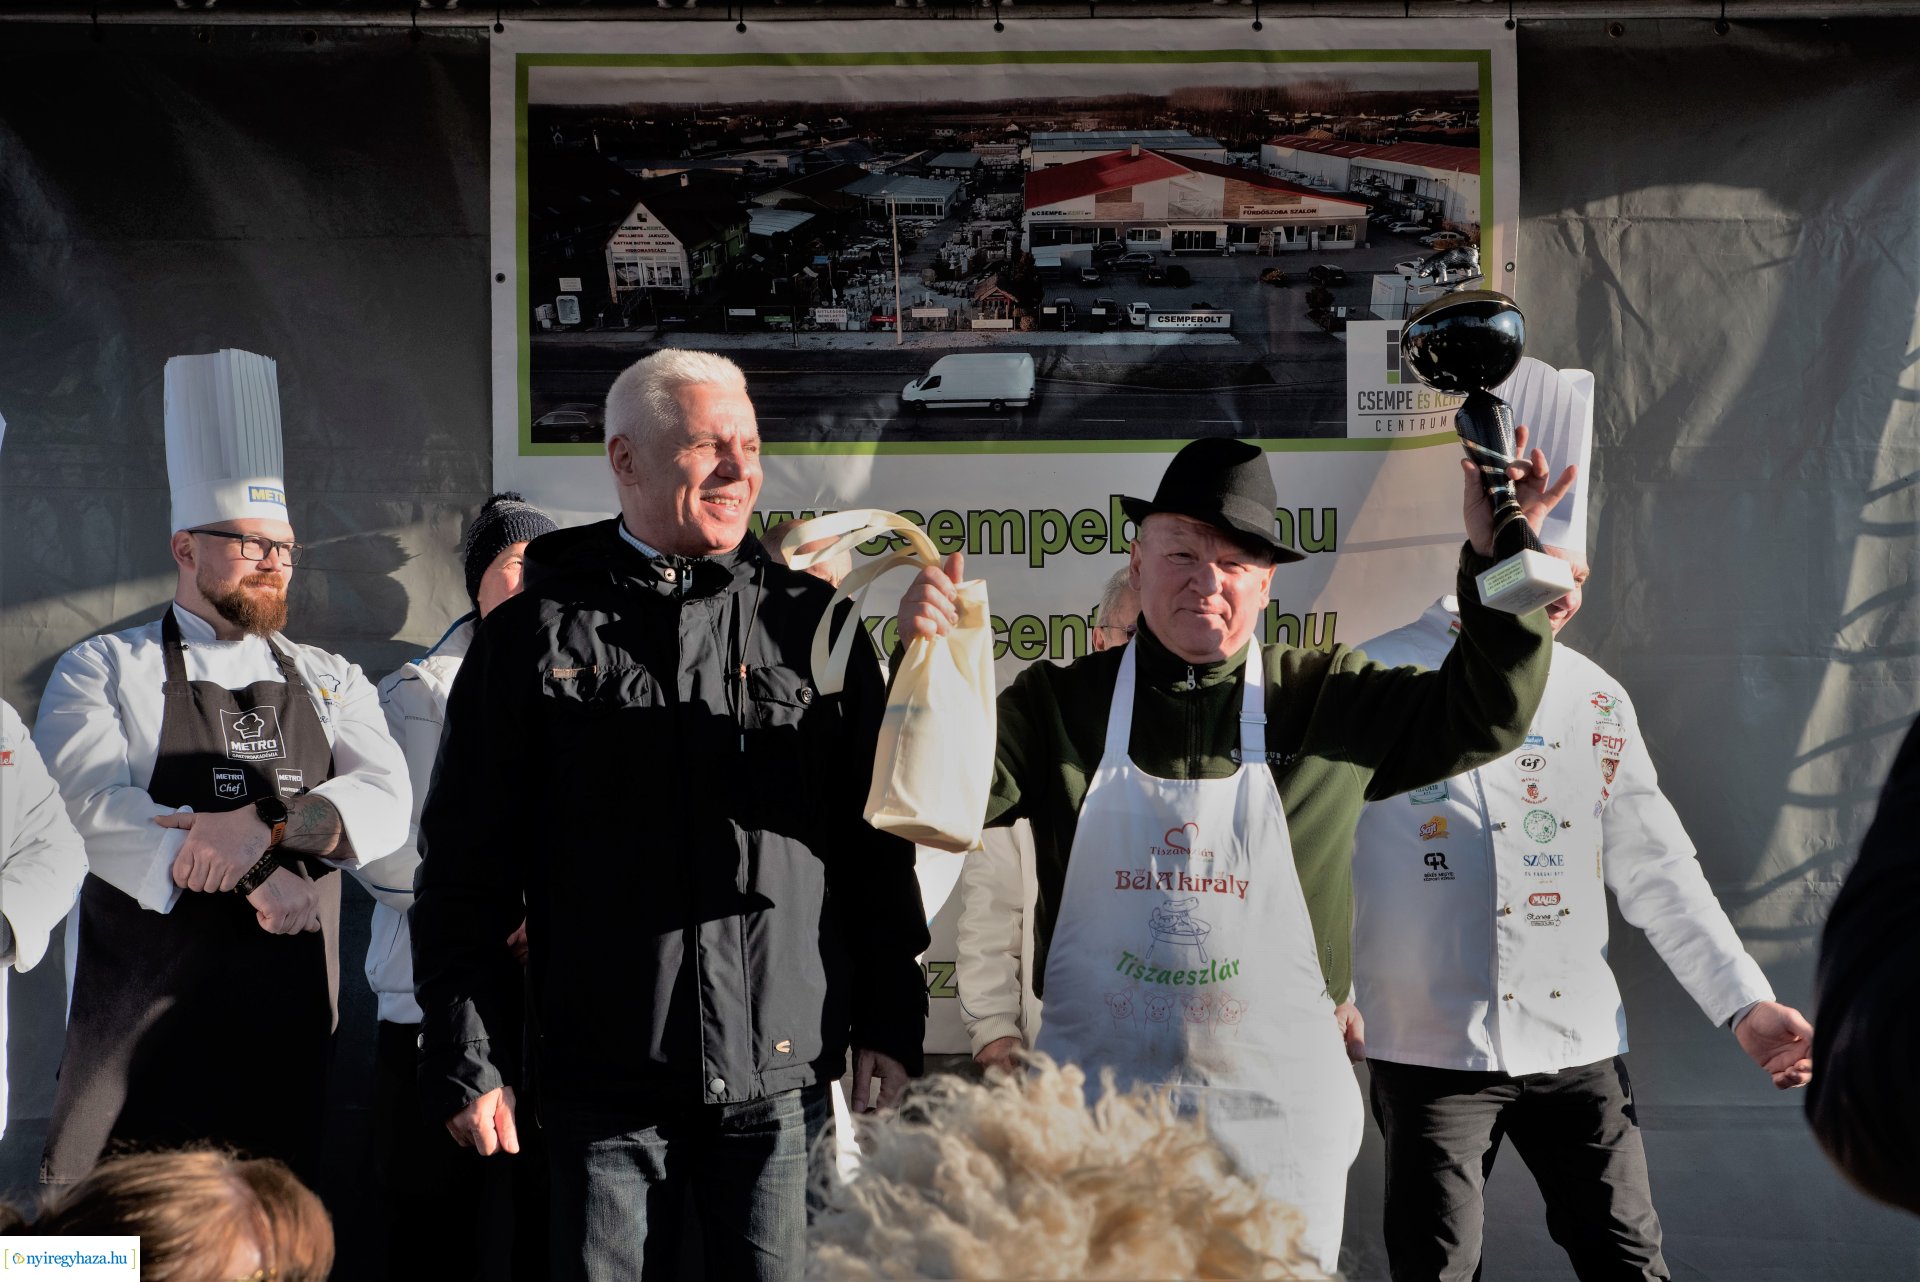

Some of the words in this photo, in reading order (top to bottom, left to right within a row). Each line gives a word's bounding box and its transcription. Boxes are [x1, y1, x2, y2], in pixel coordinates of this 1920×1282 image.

[1157, 315, 1223, 323] CSEMPEBOLT
[1357, 390, 1413, 410] CSEMPE
[1417, 390, 1430, 409] ÉS
[1375, 415, 1447, 432] CENTRUM
[230, 739, 277, 751] METRO
[278, 774, 302, 782] METRO
[219, 782, 242, 794] Chef
[1116, 950, 1240, 986] Tiszaeszlár
